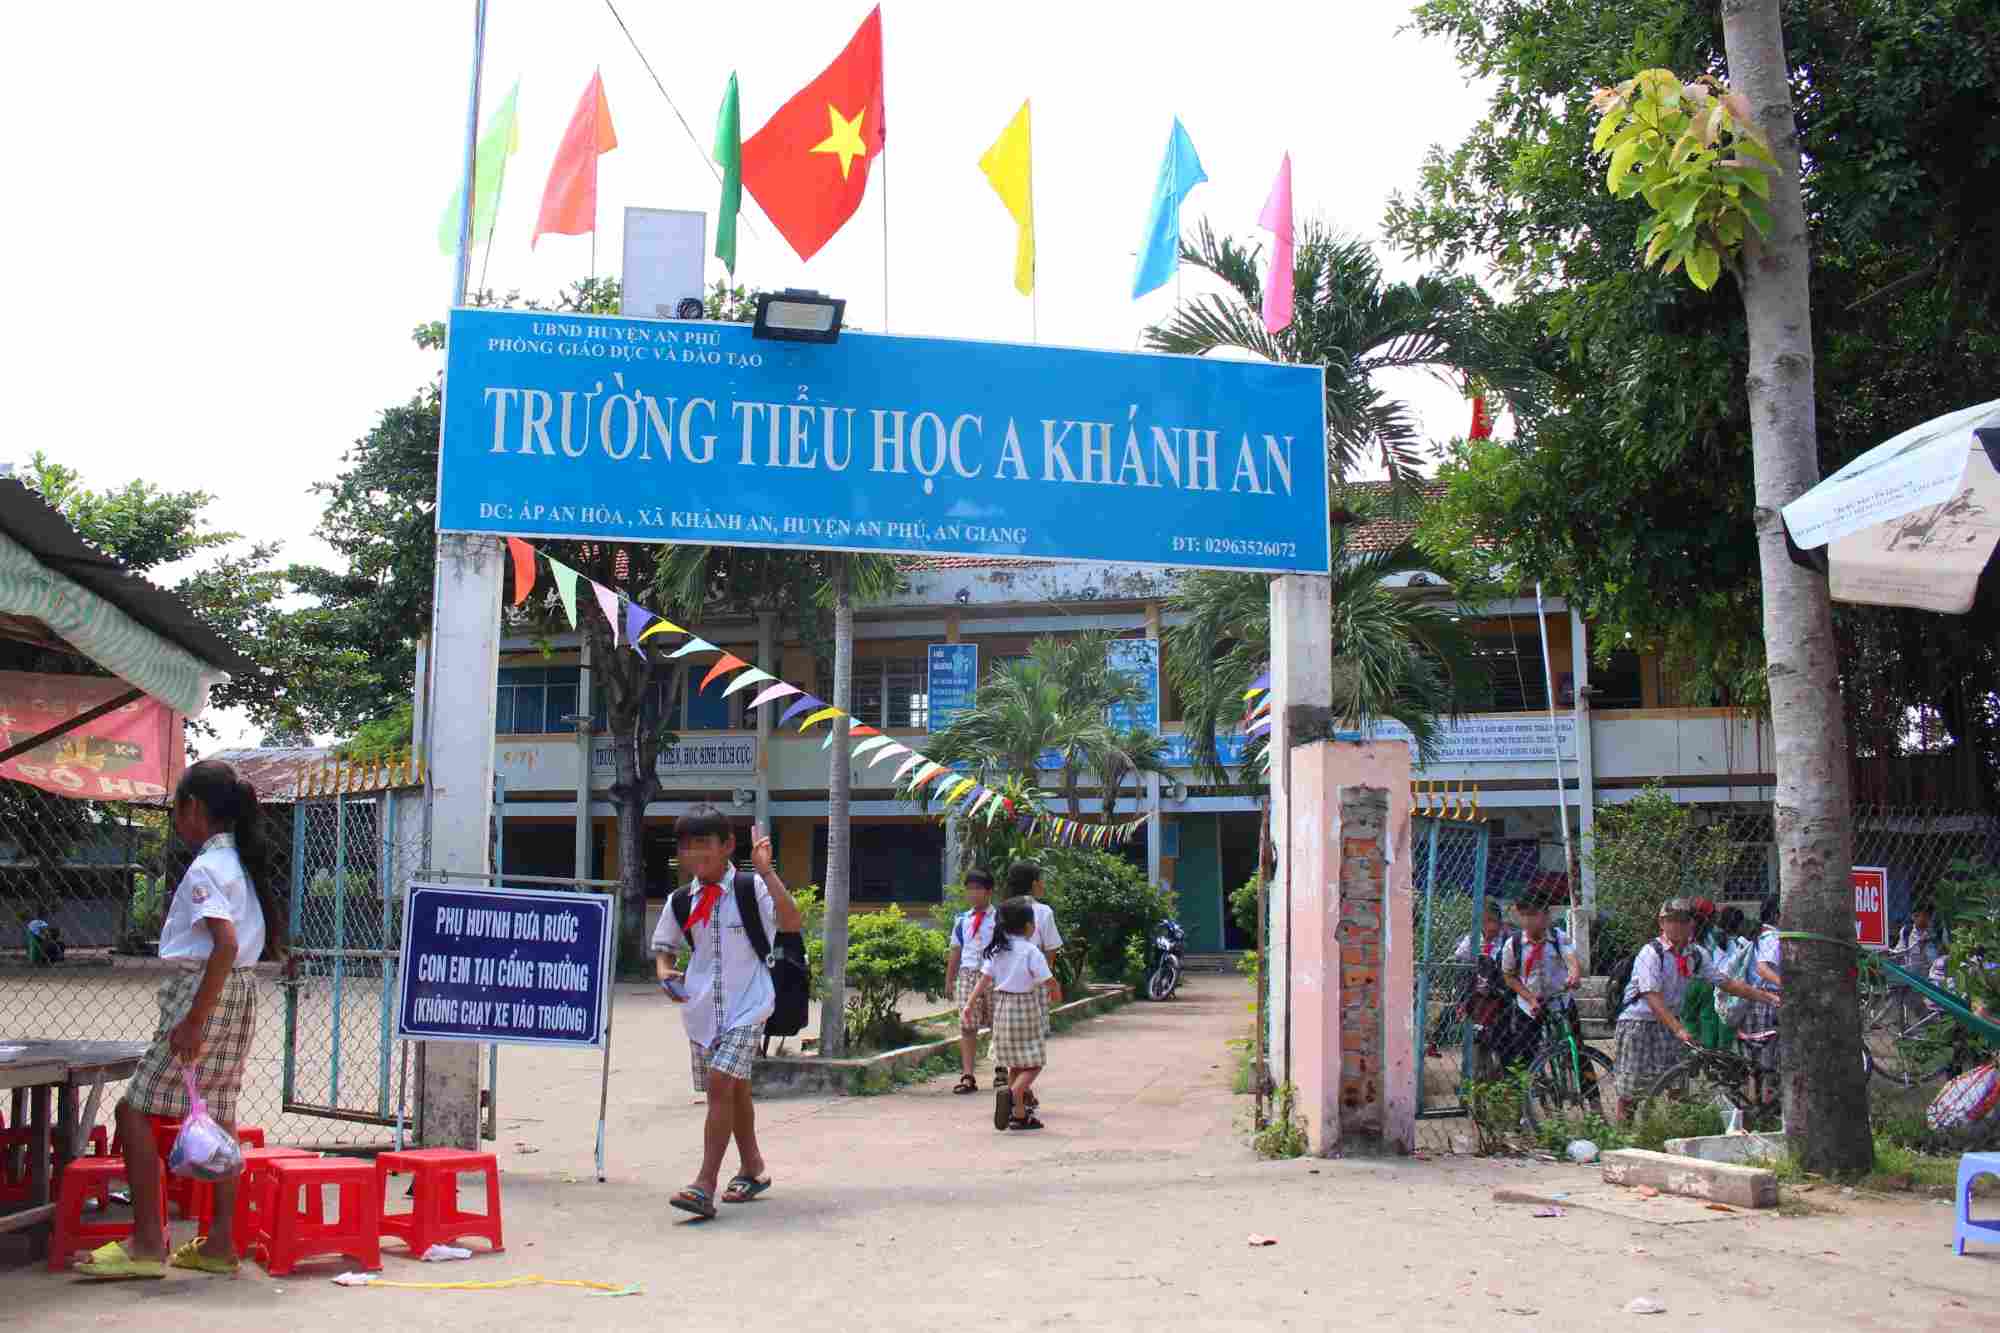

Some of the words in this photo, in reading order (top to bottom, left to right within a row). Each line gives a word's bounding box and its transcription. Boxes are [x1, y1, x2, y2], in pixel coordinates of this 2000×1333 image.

[487, 336, 553, 355] PHÒNG
[558, 339, 609, 358] GIÁO
[652, 345, 678, 362] VÀ
[727, 352, 763, 369] TẠO
[532, 321, 582, 337] UBND
[586, 324, 653, 344] HUYỆN
[655, 328, 681, 343] AN
[684, 328, 721, 345] PHÚ
[483, 372, 720, 464] TRƯỜNG
[731, 384, 856, 473] TIỂU
[869, 408, 984, 496] HỌC
[993, 414, 1031, 481] A
[1040, 403, 1221, 493] KHÁNH
[1230, 432, 1296, 497] AN
[547, 505, 575, 521] AN
[637, 505, 664, 526] XÃ
[671, 507, 741, 530] KHÁNH
[746, 515, 778, 537] AN,
[783, 517, 851, 539] HUYỆN
[855, 520, 881, 536] AN
[887, 519, 930, 541] PHÚ,
[935, 523, 960, 541] AN
[964, 525, 1028, 544] GIANG
[1205, 536, 1297, 558] 02963526072
[436, 905, 464, 942] PHỤ
[465, 909, 511, 938] HUYNH
[513, 912, 540, 942] ĐƯA
[543, 909, 579, 944] RƯỚC
[418, 953, 447, 982] CON
[449, 956, 472, 985] EM
[473, 958, 495, 992] TẠI
[498, 949, 534, 989] CỔNG
[413, 993, 457, 1025] (KHÔNG
[460, 1000, 492, 1031] CHẠY
[494, 1002, 509, 1026] XE
[512, 999, 534, 1030] VÀO
[537, 1000, 587, 1034] TRƯỜNG)
